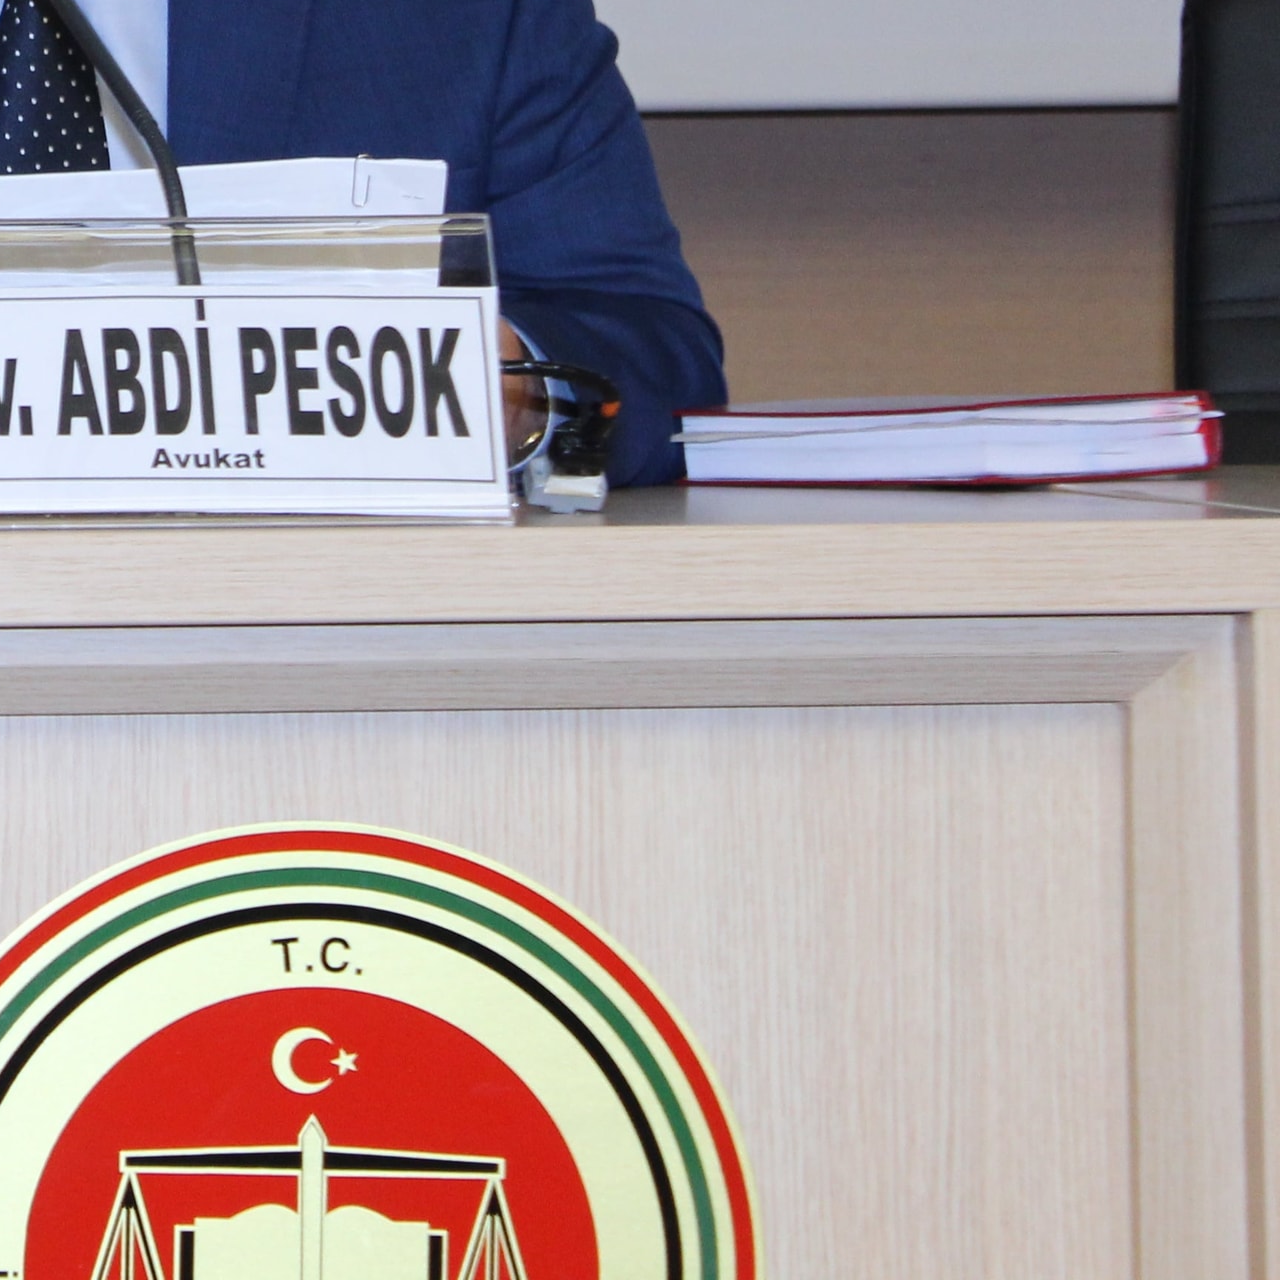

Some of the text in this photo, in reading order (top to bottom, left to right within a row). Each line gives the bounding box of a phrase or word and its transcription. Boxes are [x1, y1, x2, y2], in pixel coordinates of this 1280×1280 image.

[56, 298, 217, 437] ABDİ
[237, 324, 471, 439] PESOK
[150, 446, 266, 470] Avukat
[270, 936, 364, 976] T.C.
